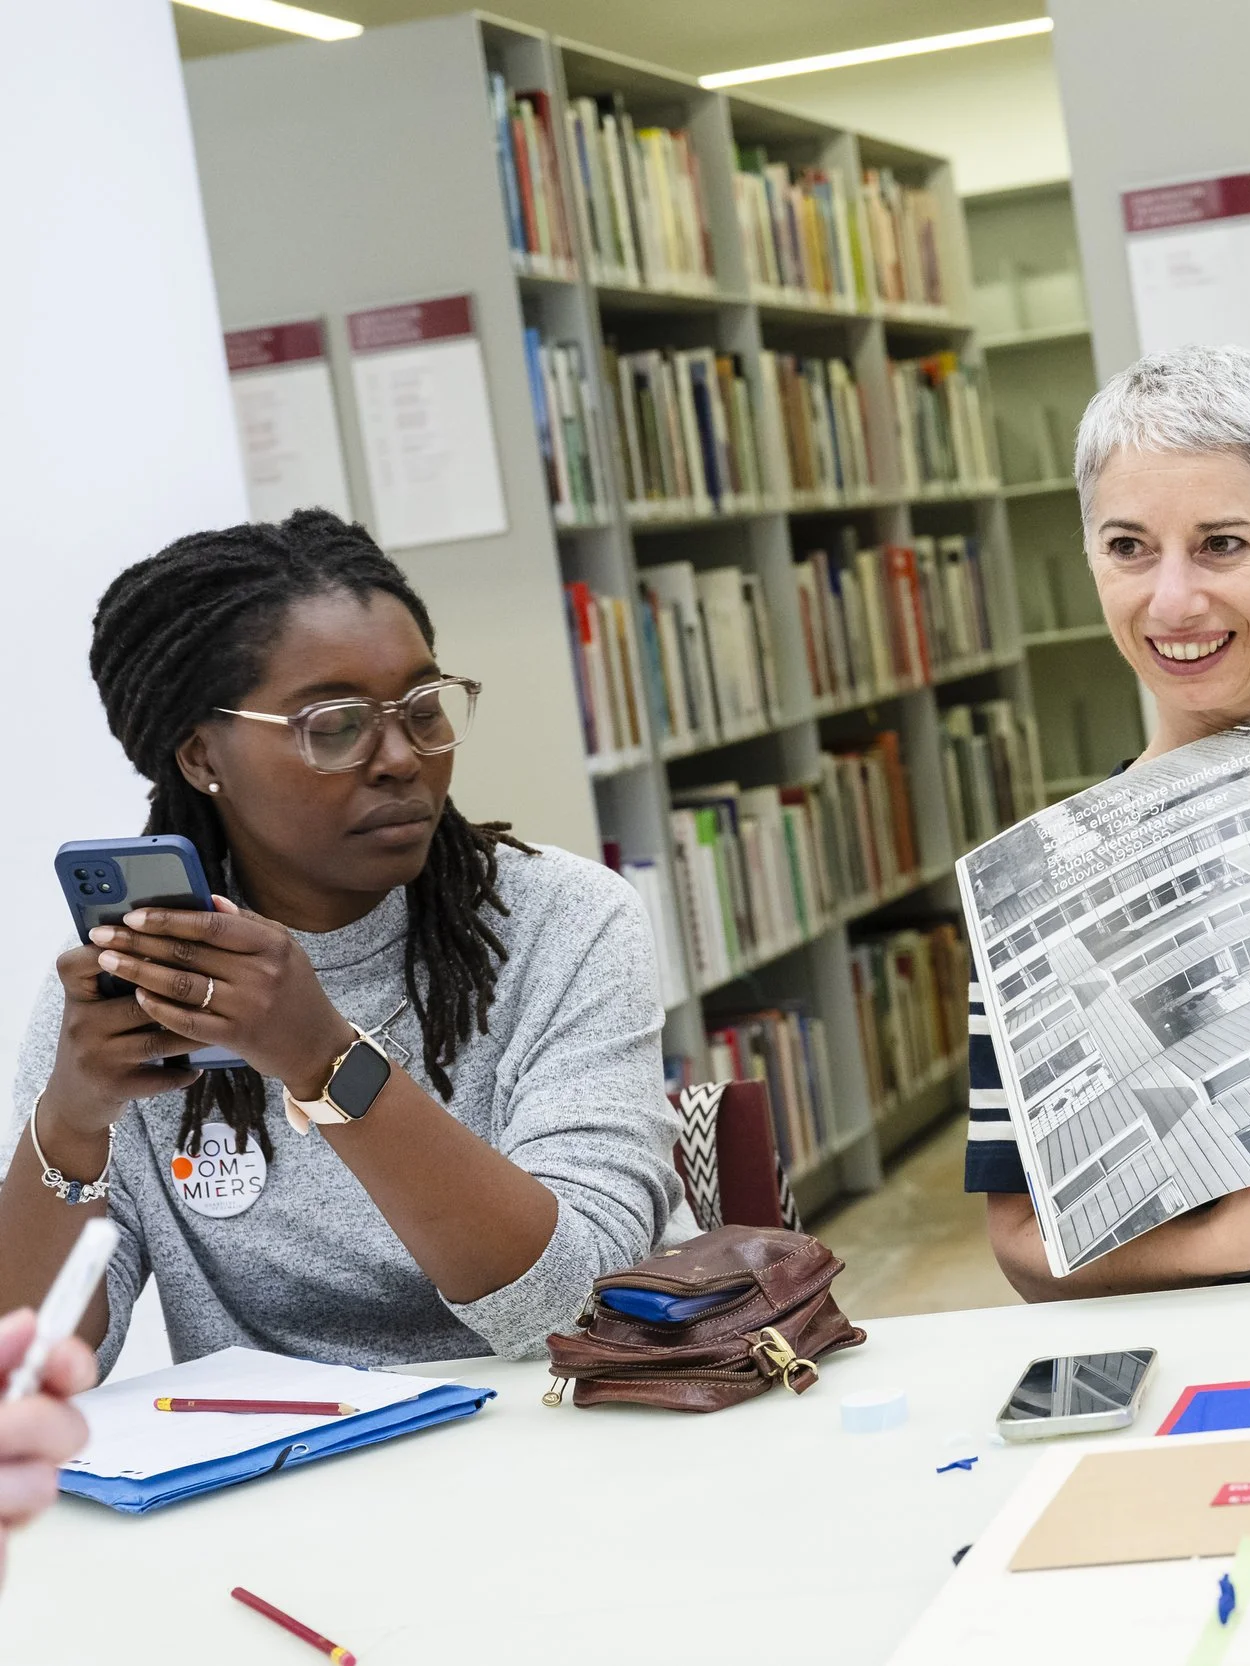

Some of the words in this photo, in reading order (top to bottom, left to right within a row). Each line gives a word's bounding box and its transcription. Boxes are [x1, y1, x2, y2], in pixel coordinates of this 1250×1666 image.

[1043, 822, 1087, 853] scuola
[1090, 787, 1169, 829] elementare
[1071, 788, 1131, 824] jacobsen
[1050, 851, 1093, 879] scuola
[1097, 812, 1176, 855] elementare
[1179, 791, 1229, 817] nyager
[1053, 861, 1108, 894] rødovre,
[184, 1176, 262, 1200] MIERS
